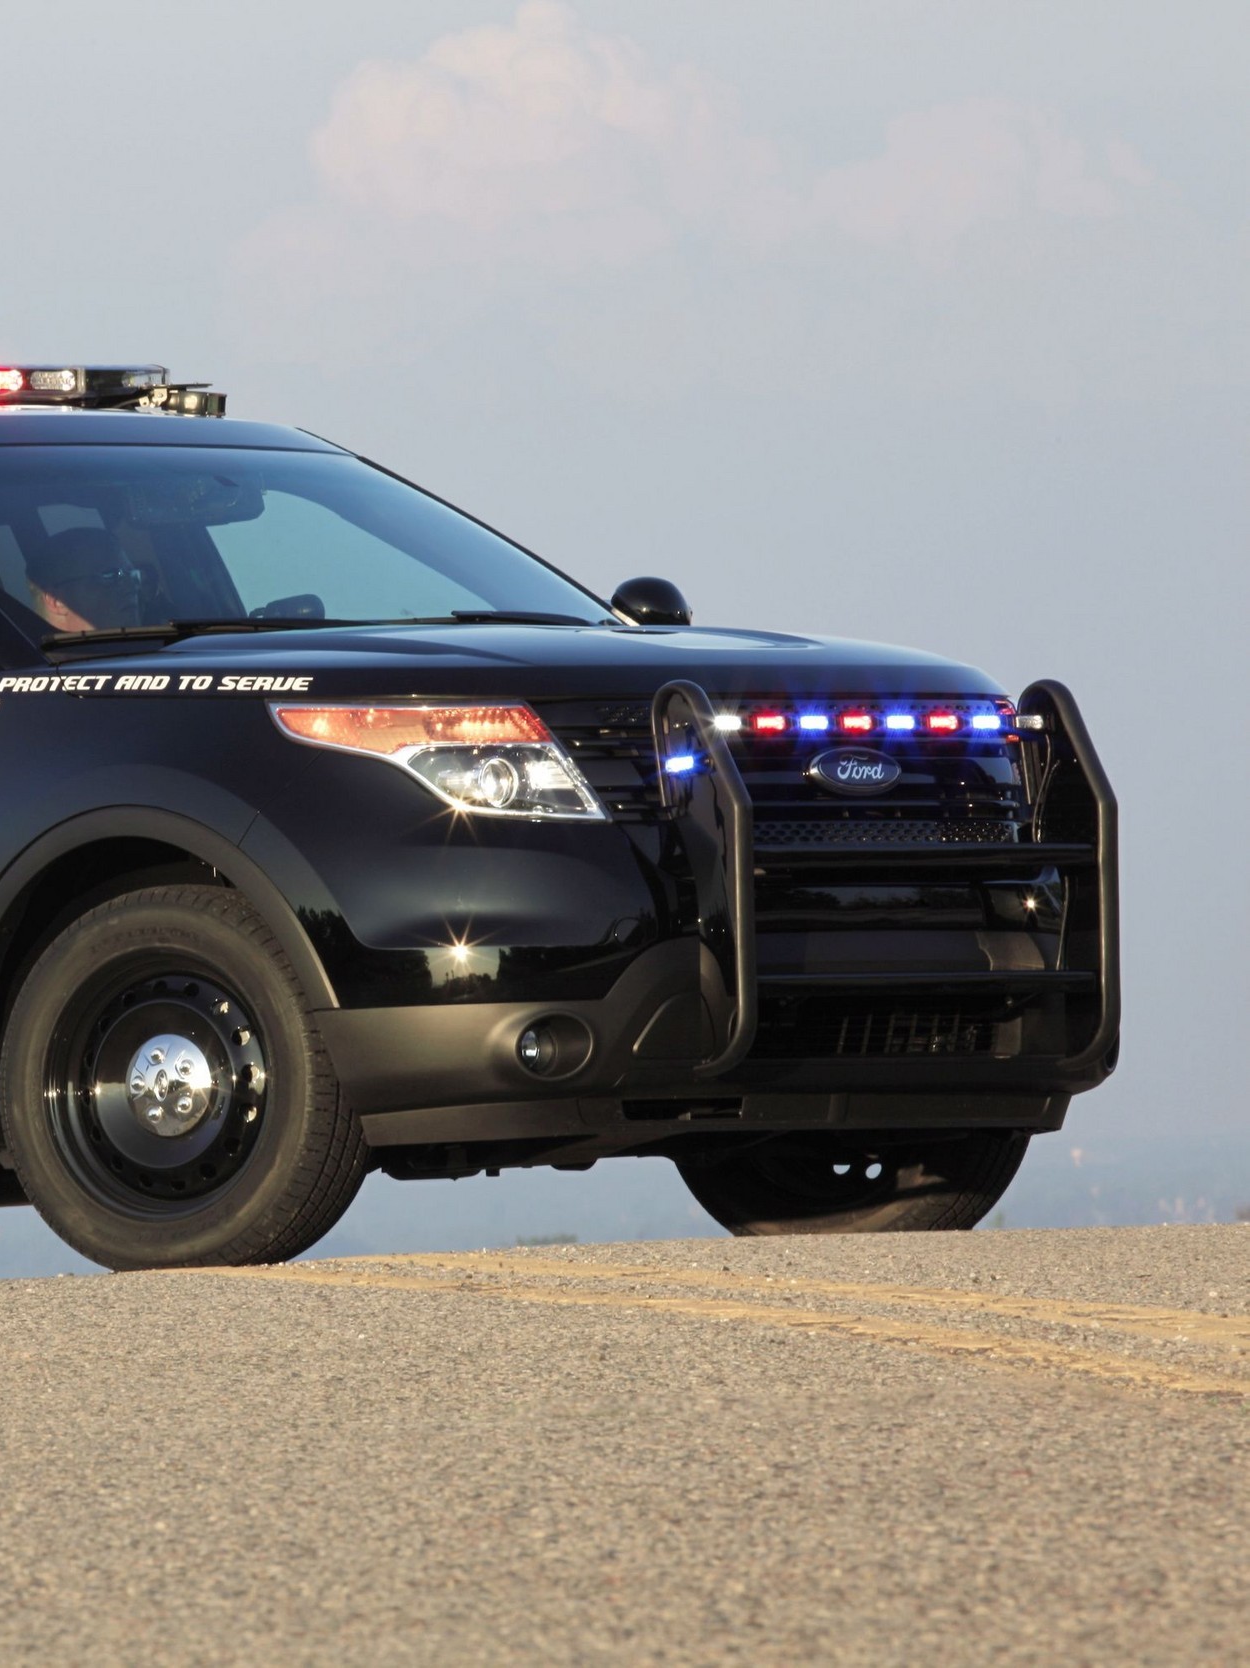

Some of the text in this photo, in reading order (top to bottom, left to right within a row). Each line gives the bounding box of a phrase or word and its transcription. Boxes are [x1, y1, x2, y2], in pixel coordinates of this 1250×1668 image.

[114, 675, 171, 691] AND
[178, 675, 214, 691] TO
[837, 753, 885, 780] Ford
